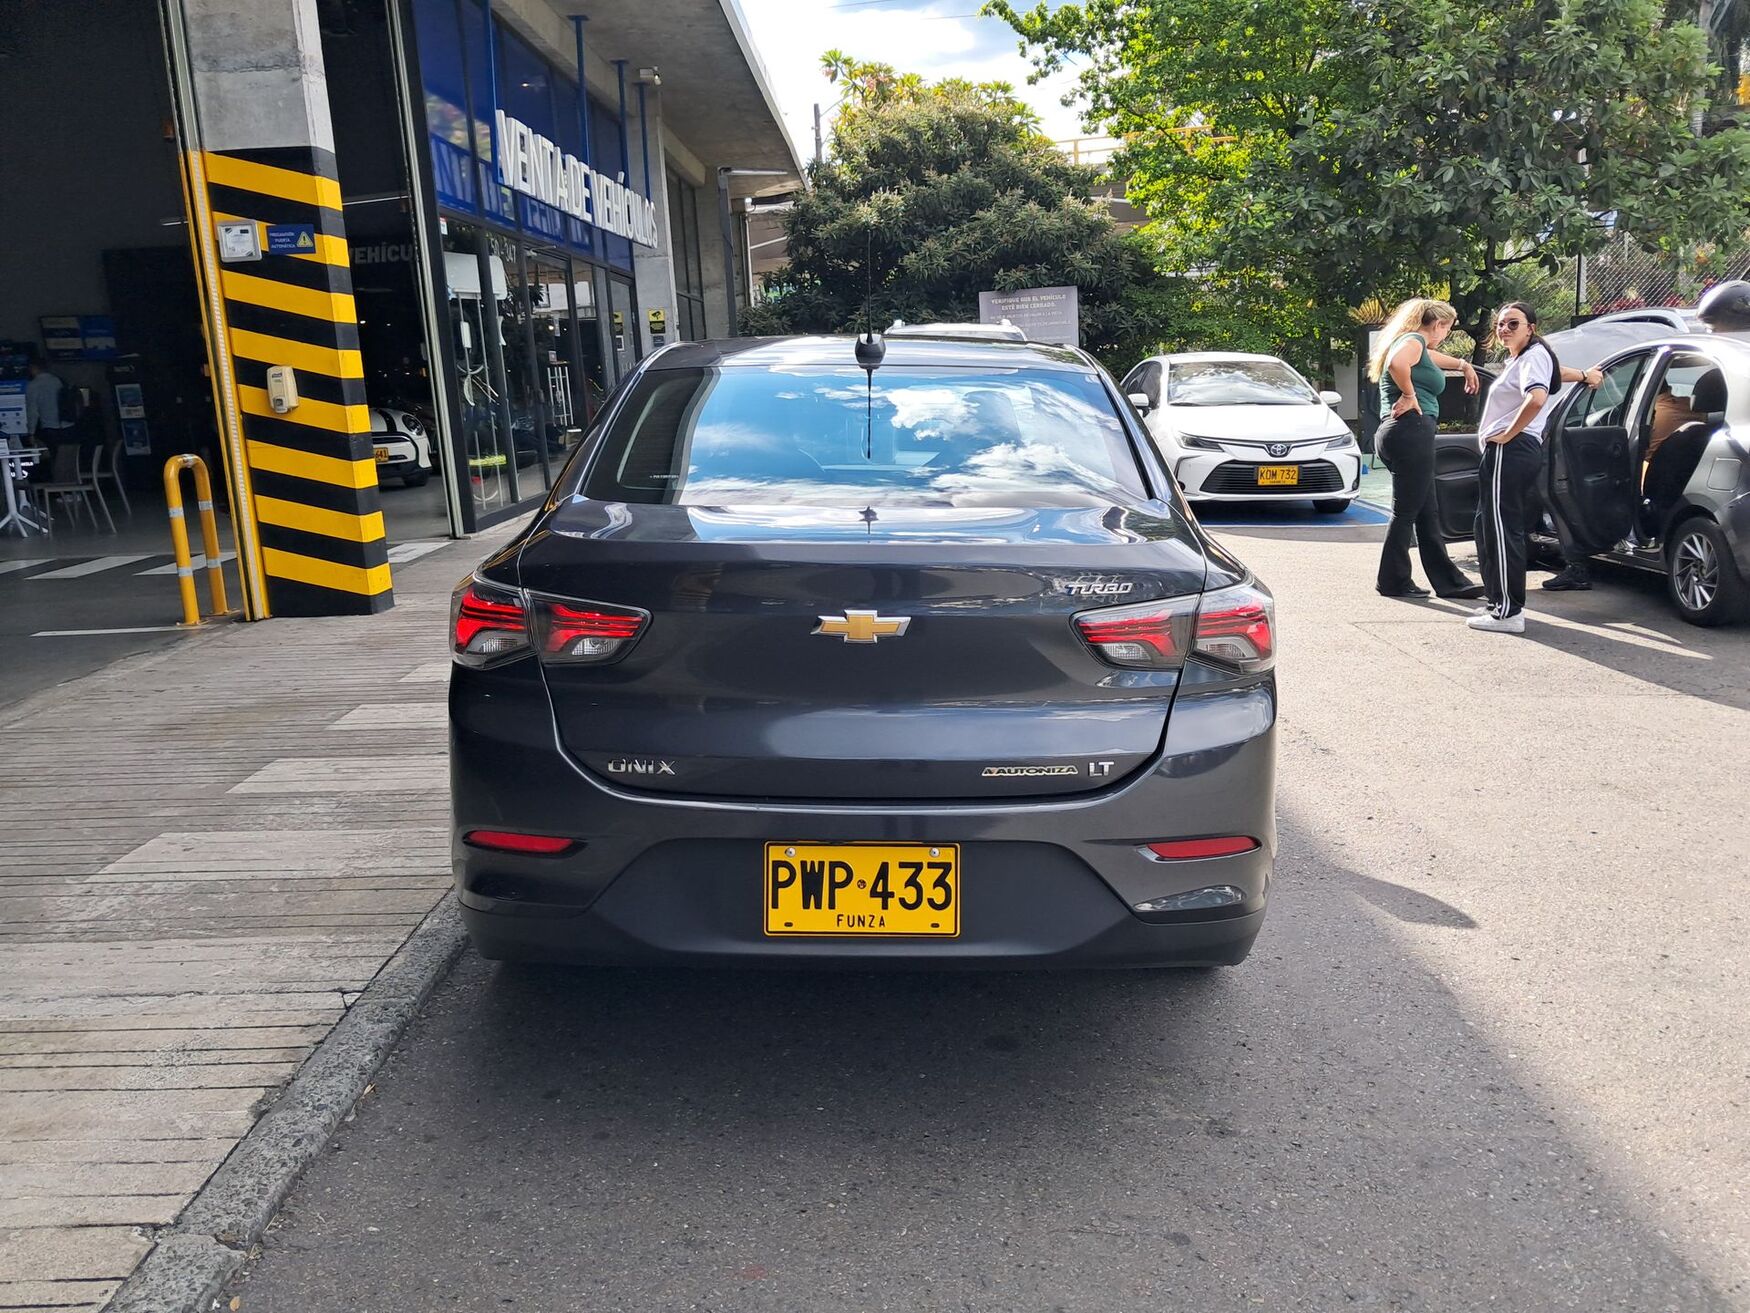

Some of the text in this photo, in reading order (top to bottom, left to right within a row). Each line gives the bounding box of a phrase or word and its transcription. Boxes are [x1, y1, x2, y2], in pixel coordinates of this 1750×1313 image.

[496, 109, 569, 211] VENTA
[565, 154, 592, 223] DE
[590, 171, 658, 249] VEHÍCULOS
[991, 296, 1019, 305] VERIFIQUE
[1020, 295, 1031, 303] QUE
[1039, 293, 1066, 301] VEHÍCULO
[1260, 469, 1297, 480] KOM 732
[1065, 583, 1133, 596] TURBO
[608, 758, 676, 775] ONIX
[1088, 761, 1115, 777] LT
[771, 860, 953, 911] PWP 433
[836, 914, 886, 928] FUNZA
